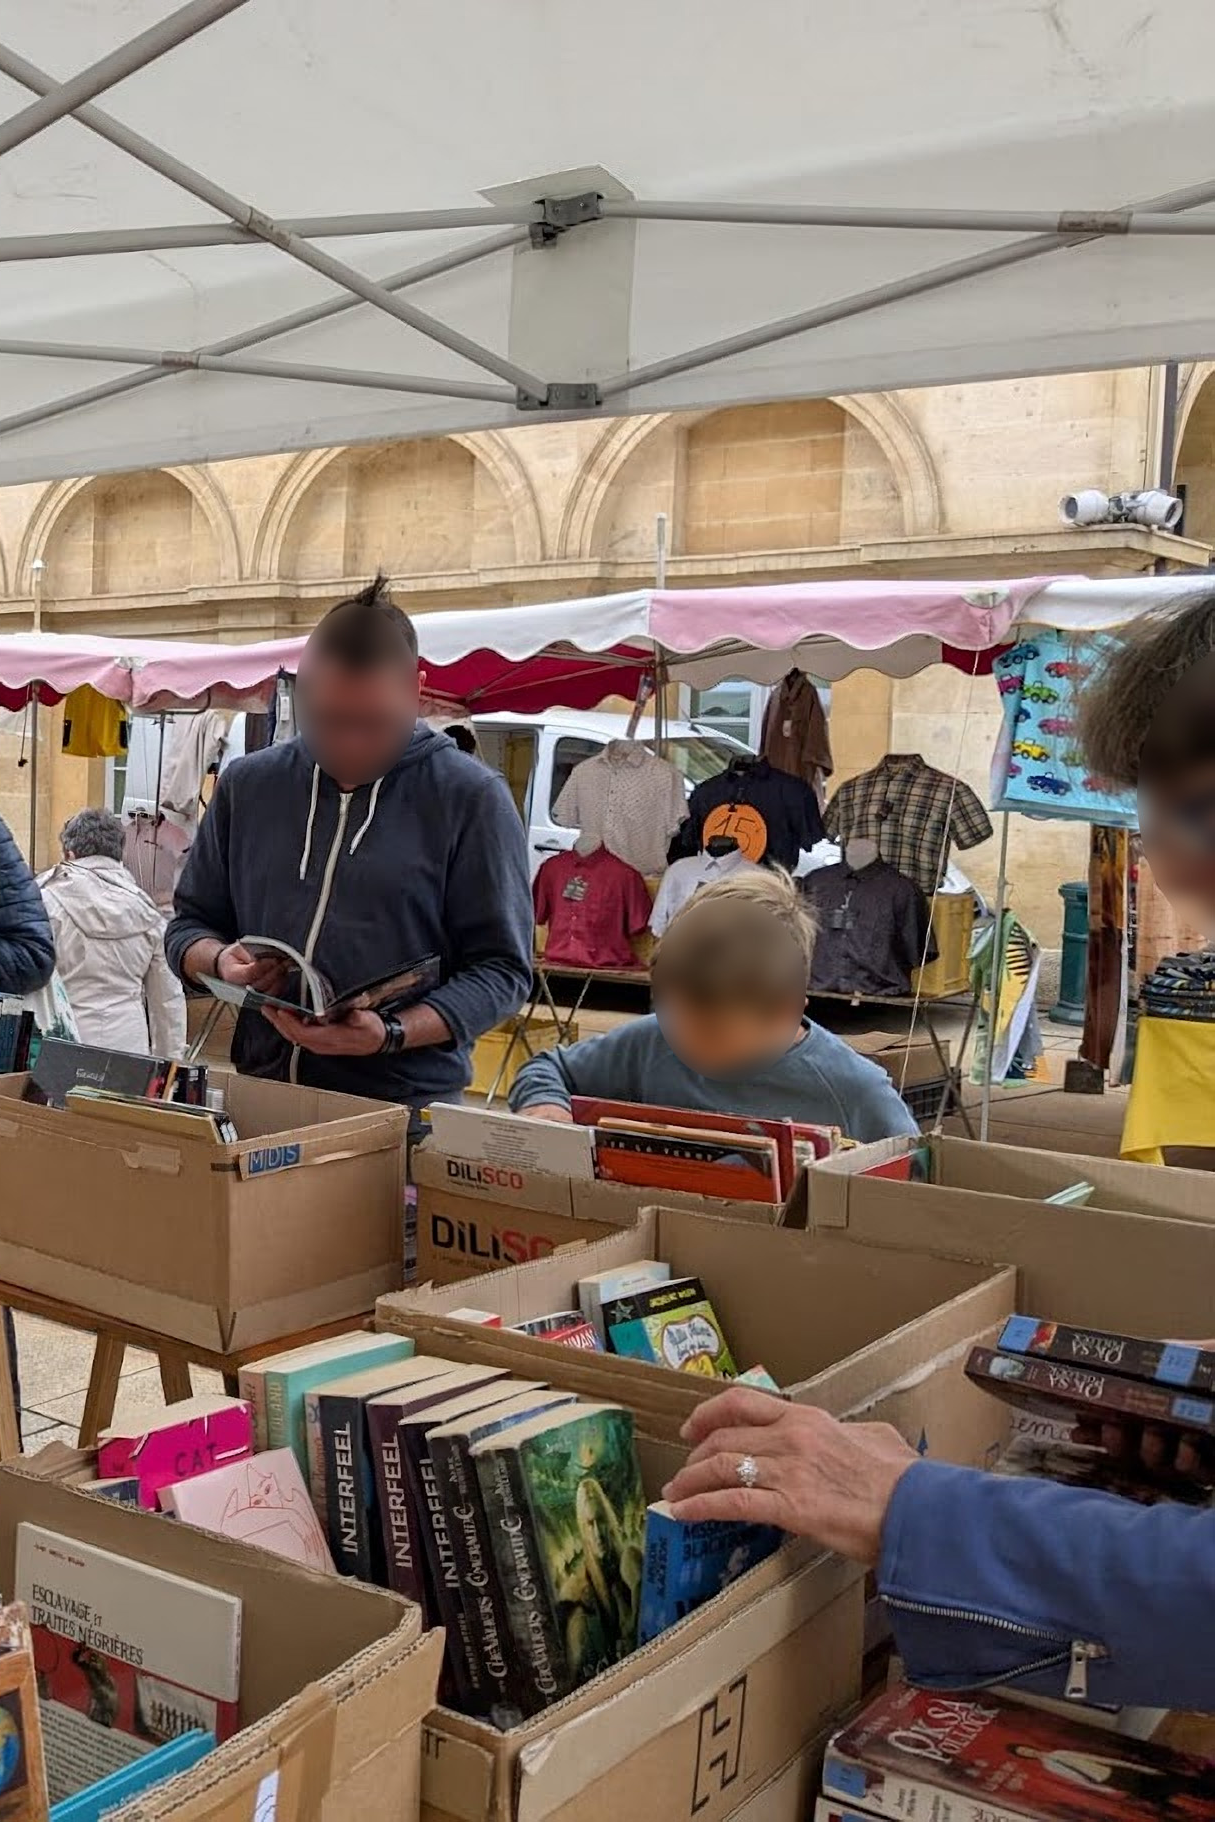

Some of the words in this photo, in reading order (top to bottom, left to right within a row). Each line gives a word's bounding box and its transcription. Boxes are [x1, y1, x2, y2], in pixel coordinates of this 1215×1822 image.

[714, 815, 755, 853] 15
[249, 1145, 297, 1172] MDS
[333, 1421, 358, 1556] INTERFEEL
[382, 1432, 414, 1569] INTERFEEL
[31, 1604, 76, 1638] TRAITES
